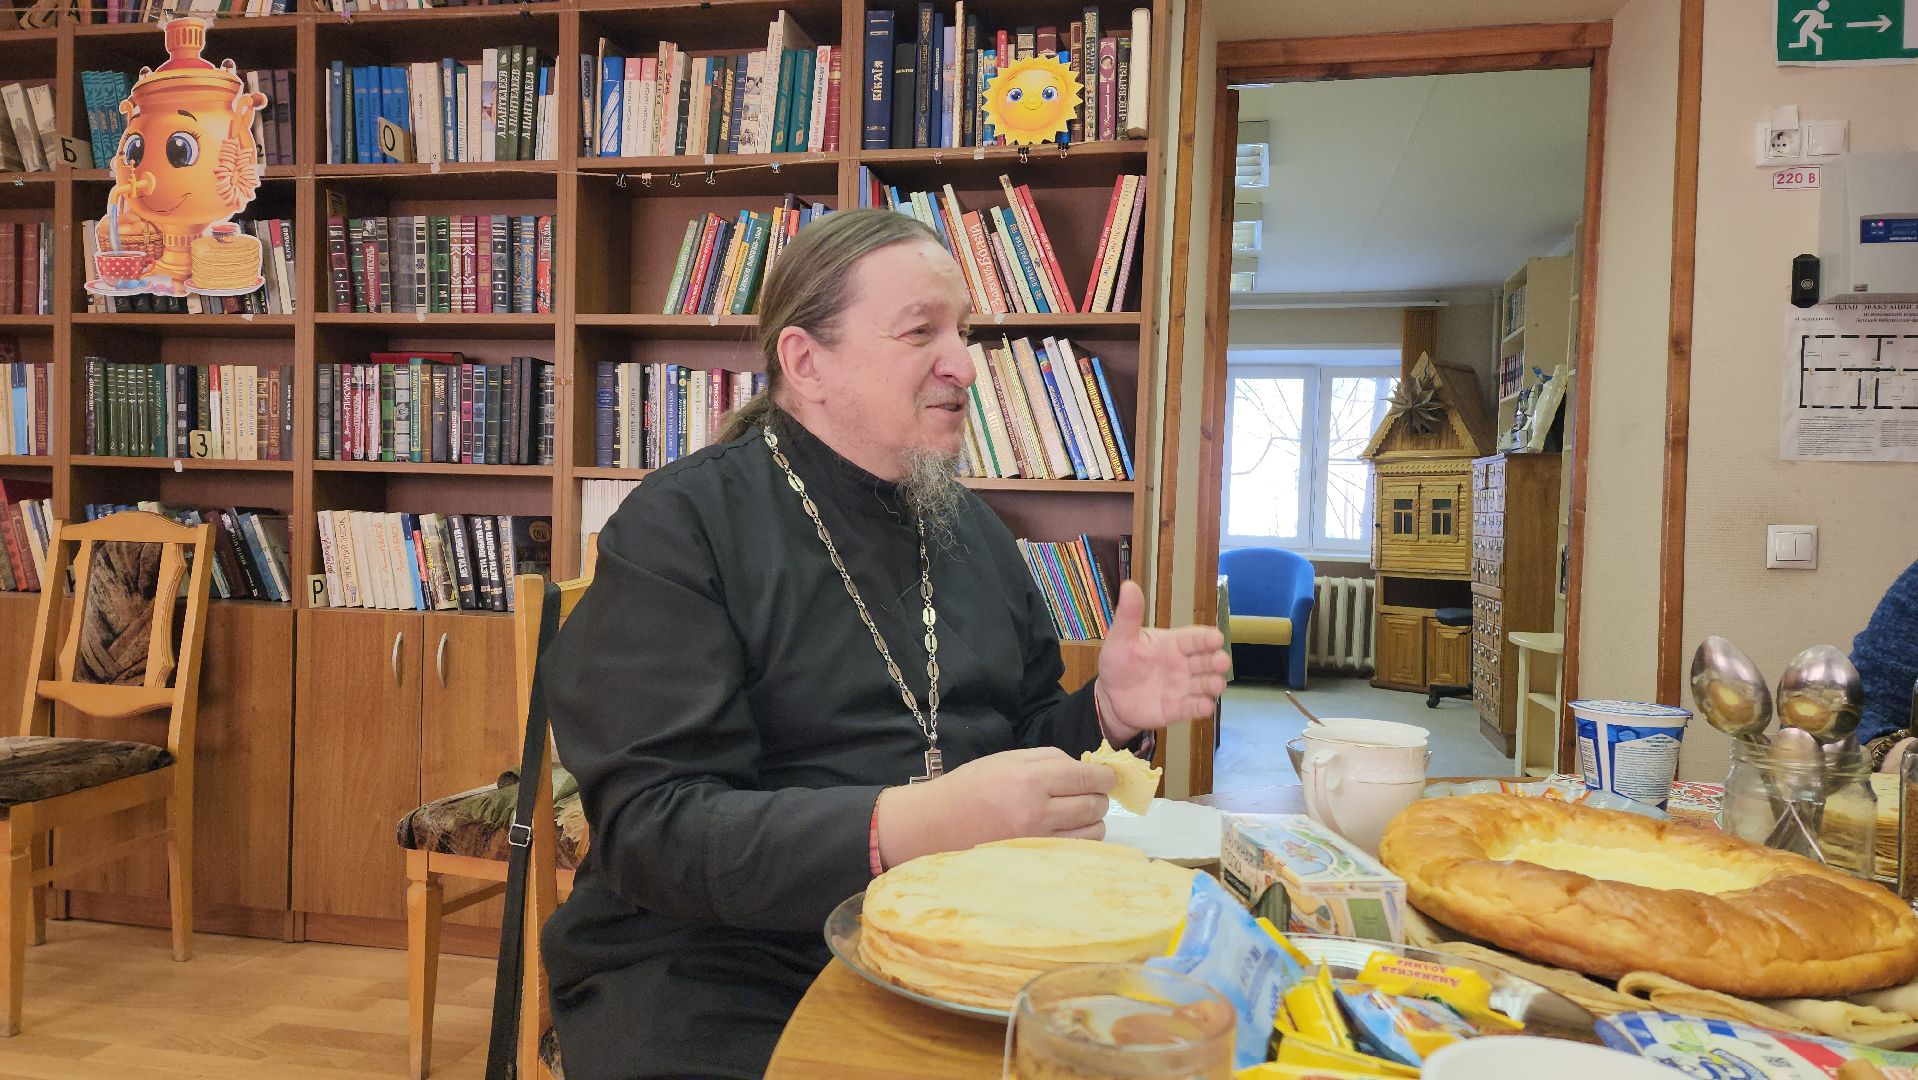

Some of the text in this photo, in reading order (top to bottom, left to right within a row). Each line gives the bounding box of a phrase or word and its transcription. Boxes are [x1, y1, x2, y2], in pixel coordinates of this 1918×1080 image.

[60, 137, 78, 163] Б
[383, 124, 396, 152] О
[1776, 173, 1802, 184] 220
[312, 580, 323, 604] Р
